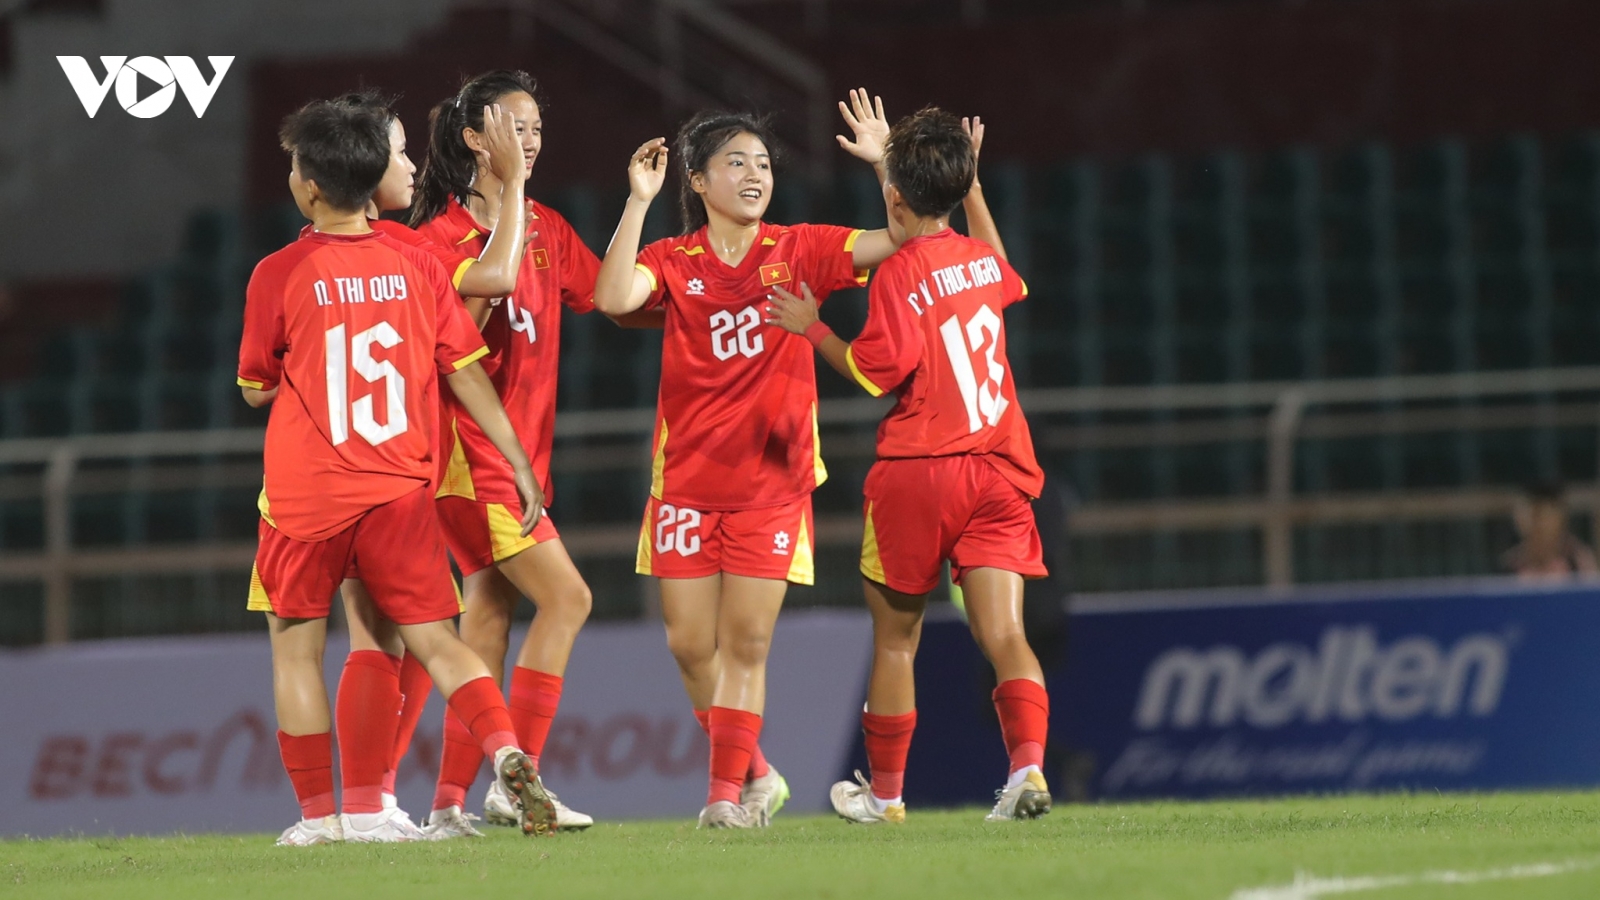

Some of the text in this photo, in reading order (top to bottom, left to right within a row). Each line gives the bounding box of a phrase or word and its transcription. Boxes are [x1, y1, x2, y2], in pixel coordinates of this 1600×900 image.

[334, 277, 365, 304] THI
[369, 275, 408, 302] QUY
[931, 263, 973, 298] THUC
[968, 256, 1002, 288] NGHI
[507, 295, 537, 344] 4
[709, 305, 764, 361] 22
[325, 320, 408, 447] 15
[939, 303, 1010, 434] 13
[656, 504, 701, 557] 22
[1135, 624, 1508, 729] molten
